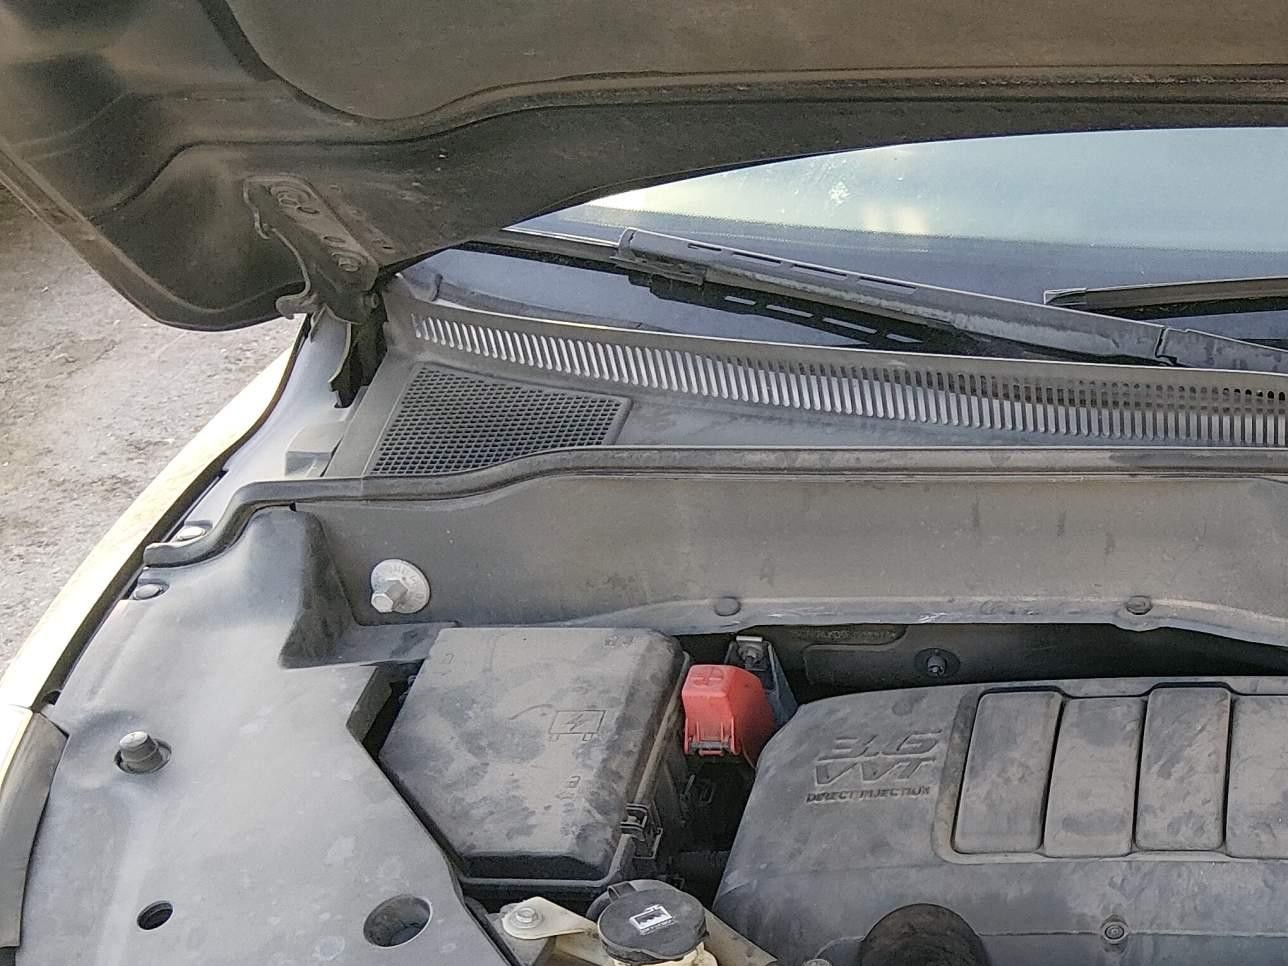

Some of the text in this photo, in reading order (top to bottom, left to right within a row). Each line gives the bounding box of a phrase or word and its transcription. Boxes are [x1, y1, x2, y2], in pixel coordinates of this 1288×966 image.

[816, 729, 943, 762] 3.6
[814, 756, 937, 786] VVT
[805, 786, 931, 804] DIRECT INJECTION
